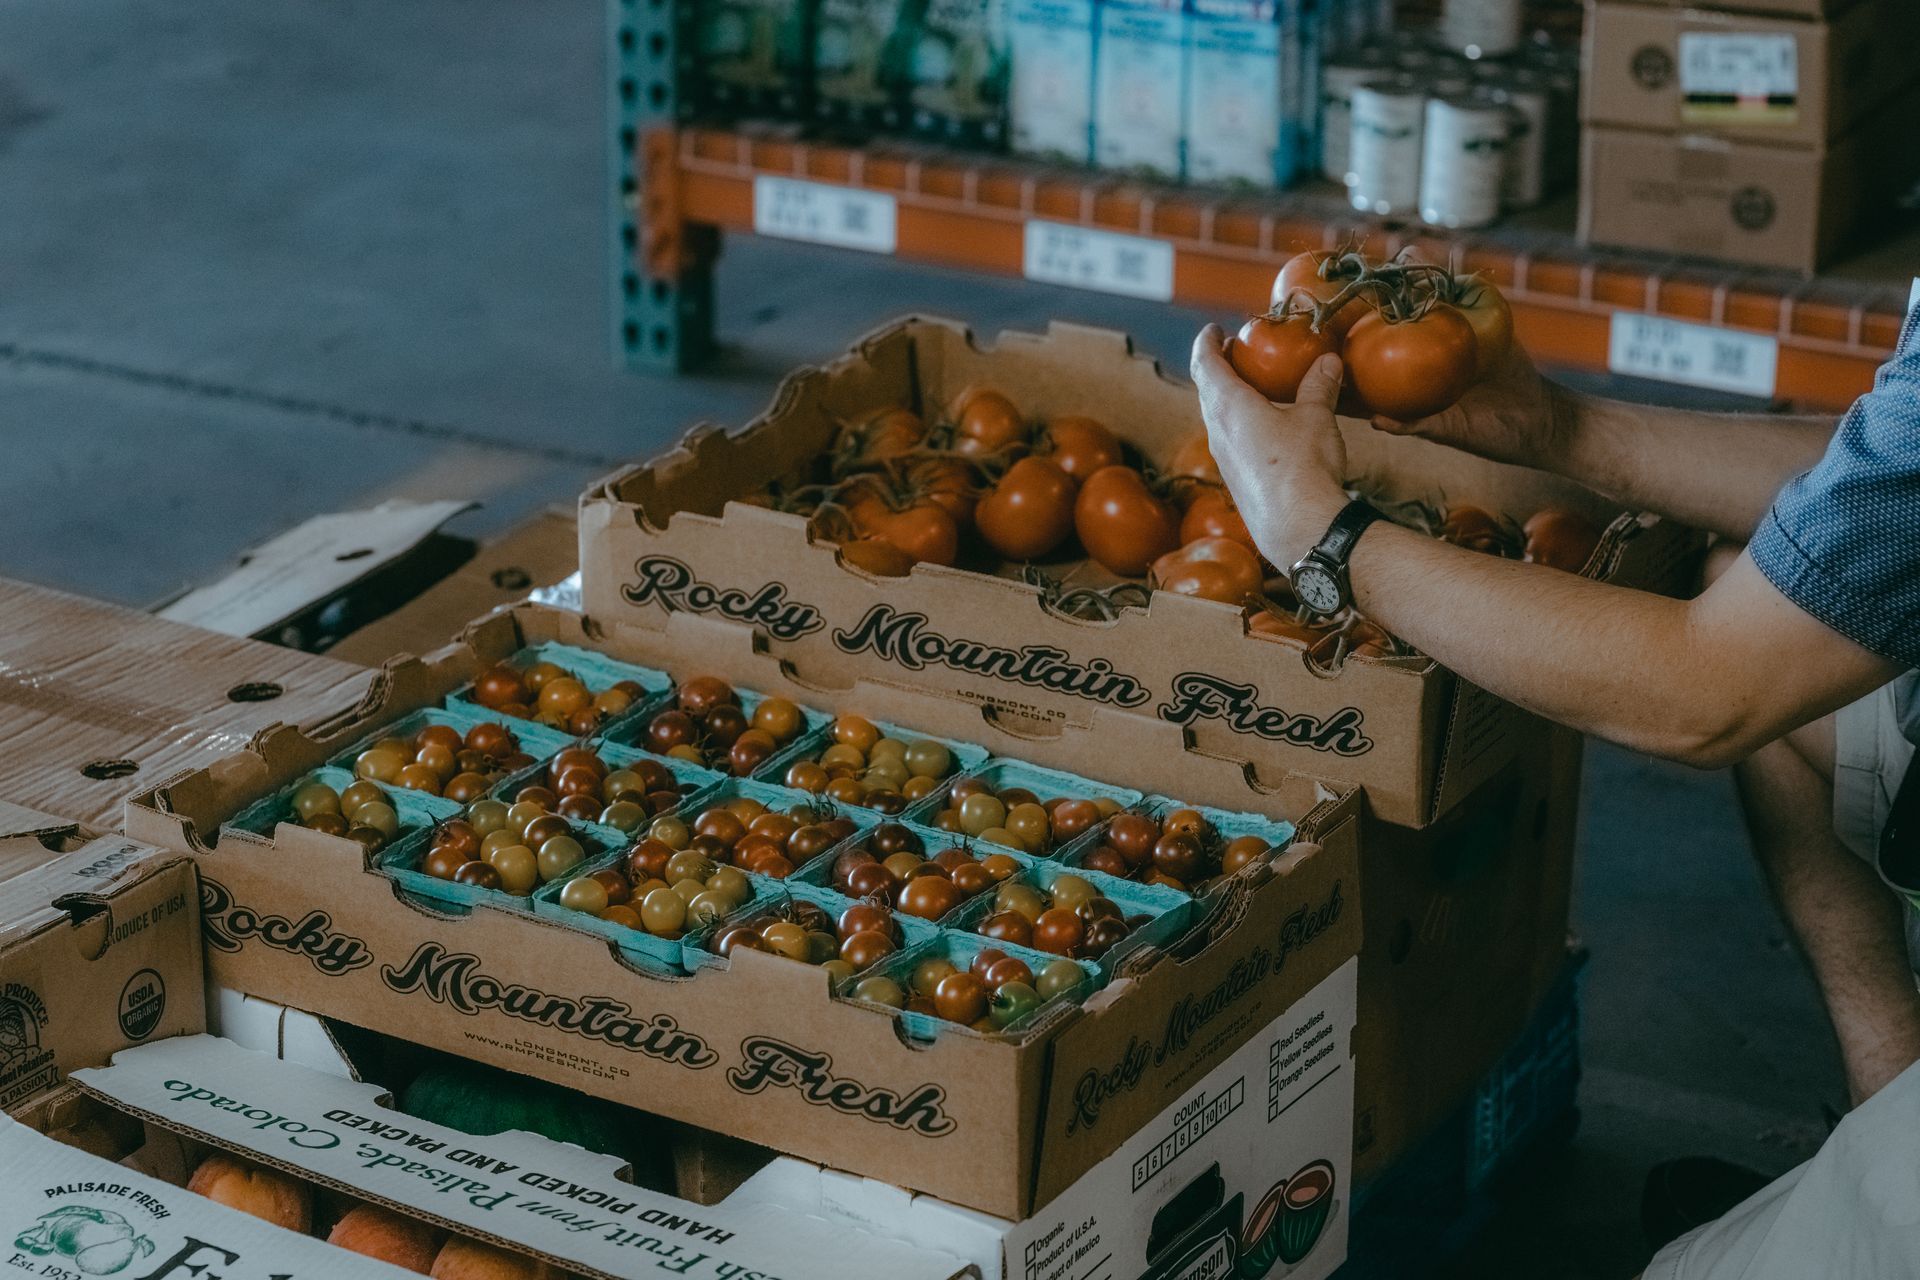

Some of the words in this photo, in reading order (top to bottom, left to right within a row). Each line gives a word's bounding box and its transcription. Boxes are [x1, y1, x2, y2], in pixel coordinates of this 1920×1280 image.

[620, 554, 826, 640] Rocky
[832, 604, 1151, 708] Mountain
[1158, 672, 1374, 755] Fresh
[111, 911, 149, 944] ODUCE
[151, 904, 164, 924] OF
[166, 893, 186, 916] USA
[5, 983, 49, 1029] PRODUCE
[126, 1000, 160, 1026] ORGANIC
[128, 983, 155, 1008] USDA
[1066, 1036, 1153, 1138] Rocky
[1154, 947, 1272, 1066] Mountain
[1273, 880, 1344, 975] Fresh
[380, 941, 719, 1071] Mountain
[727, 1035, 958, 1137] Fresh
[1280, 1048, 1301, 1070] Yellow
[1302, 1024, 1332, 1053] Seedless
[1281, 1032, 1293, 1051] Red
[1294, 1010, 1324, 1040] Seedless
[17, 1049, 55, 1077] Potatoes
[514, 1038, 603, 1070] LONGMONT,
[609, 1066, 630, 1077] CO
[1280, 1066, 1303, 1090] Orange
[1304, 1042, 1334, 1071] Seedless
[10, 1071, 48, 1100] PASSION
[163, 1078, 341, 1153] Colorado
[1173, 1091, 1206, 1126] COUNT
[322, 1108, 440, 1158] PACKED
[1137, 1167, 1143, 1180] 5
[1152, 1155, 1157, 1168] 6
[1165, 1143, 1171, 1157] 7
[1179, 1133, 1185, 1146] 8
[1193, 1122, 1199, 1135] 9
[1205, 1109, 1215, 1125] 10
[1219, 1098, 1227, 1114] 11
[358, 1141, 516, 1212] Palisade,
[447, 1148, 522, 1180] AND
[44, 1182, 131, 1199] PALISADE
[129, 1189, 172, 1220] FRESH
[522, 1172, 638, 1215] PICKED
[516, 1201, 622, 1232] from
[637, 1208, 737, 1245] HAND
[1036, 1222, 1065, 1252] Organic
[6, 1253, 34, 1271] Est.
[604, 1228, 710, 1274] Fruit
[1037, 1242, 1064, 1274] Product
[1066, 1231, 1073, 1248] of
[1074, 1215, 1097, 1240] U.S.A.
[1066, 1254, 1073, 1270] of
[1074, 1234, 1100, 1262] Mexico
